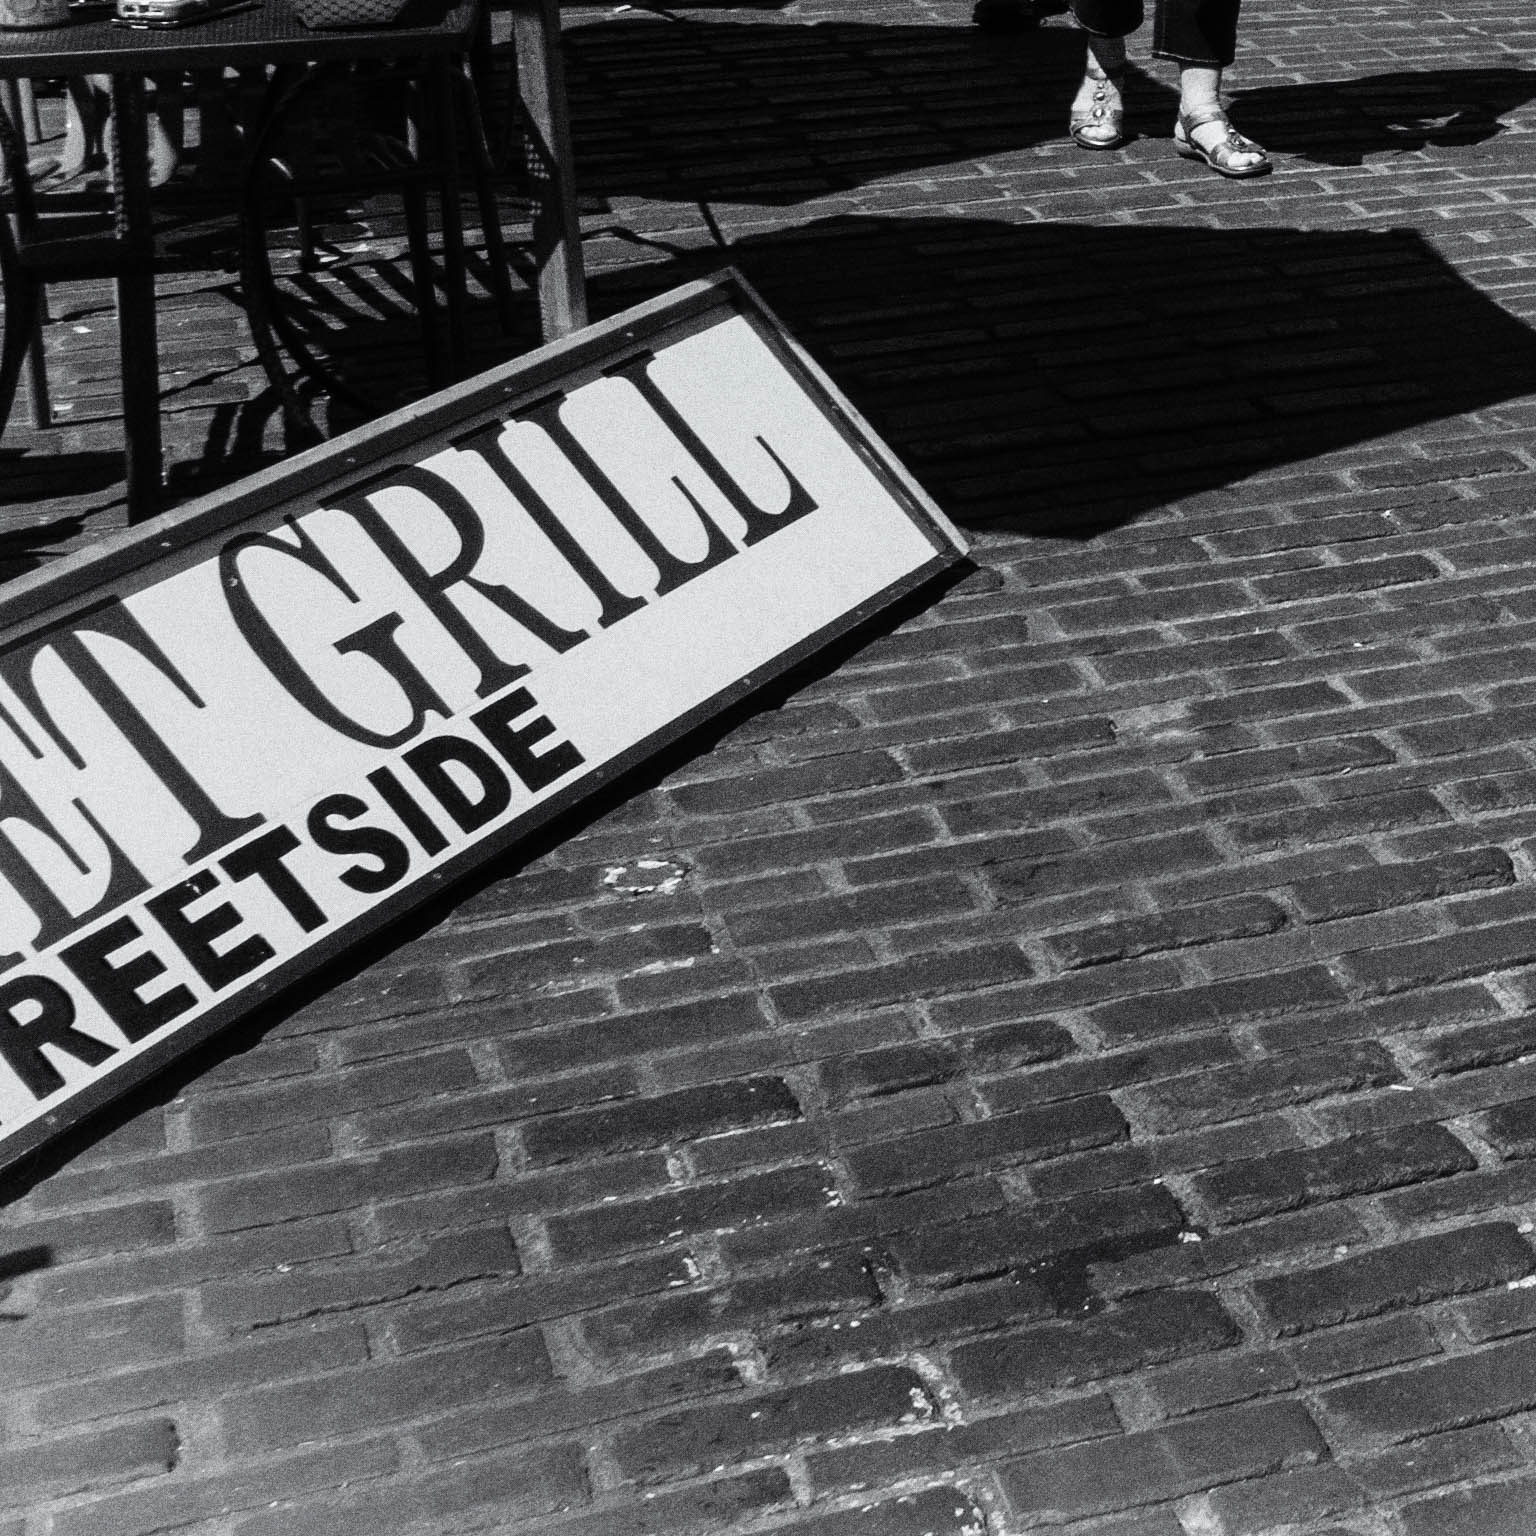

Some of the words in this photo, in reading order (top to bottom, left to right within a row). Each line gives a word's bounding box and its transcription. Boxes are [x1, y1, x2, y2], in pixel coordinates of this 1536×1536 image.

[0, 595, 266, 964] ET
[219, 351, 819, 750] GRILL
[0, 685, 587, 1102] REETSIDE
